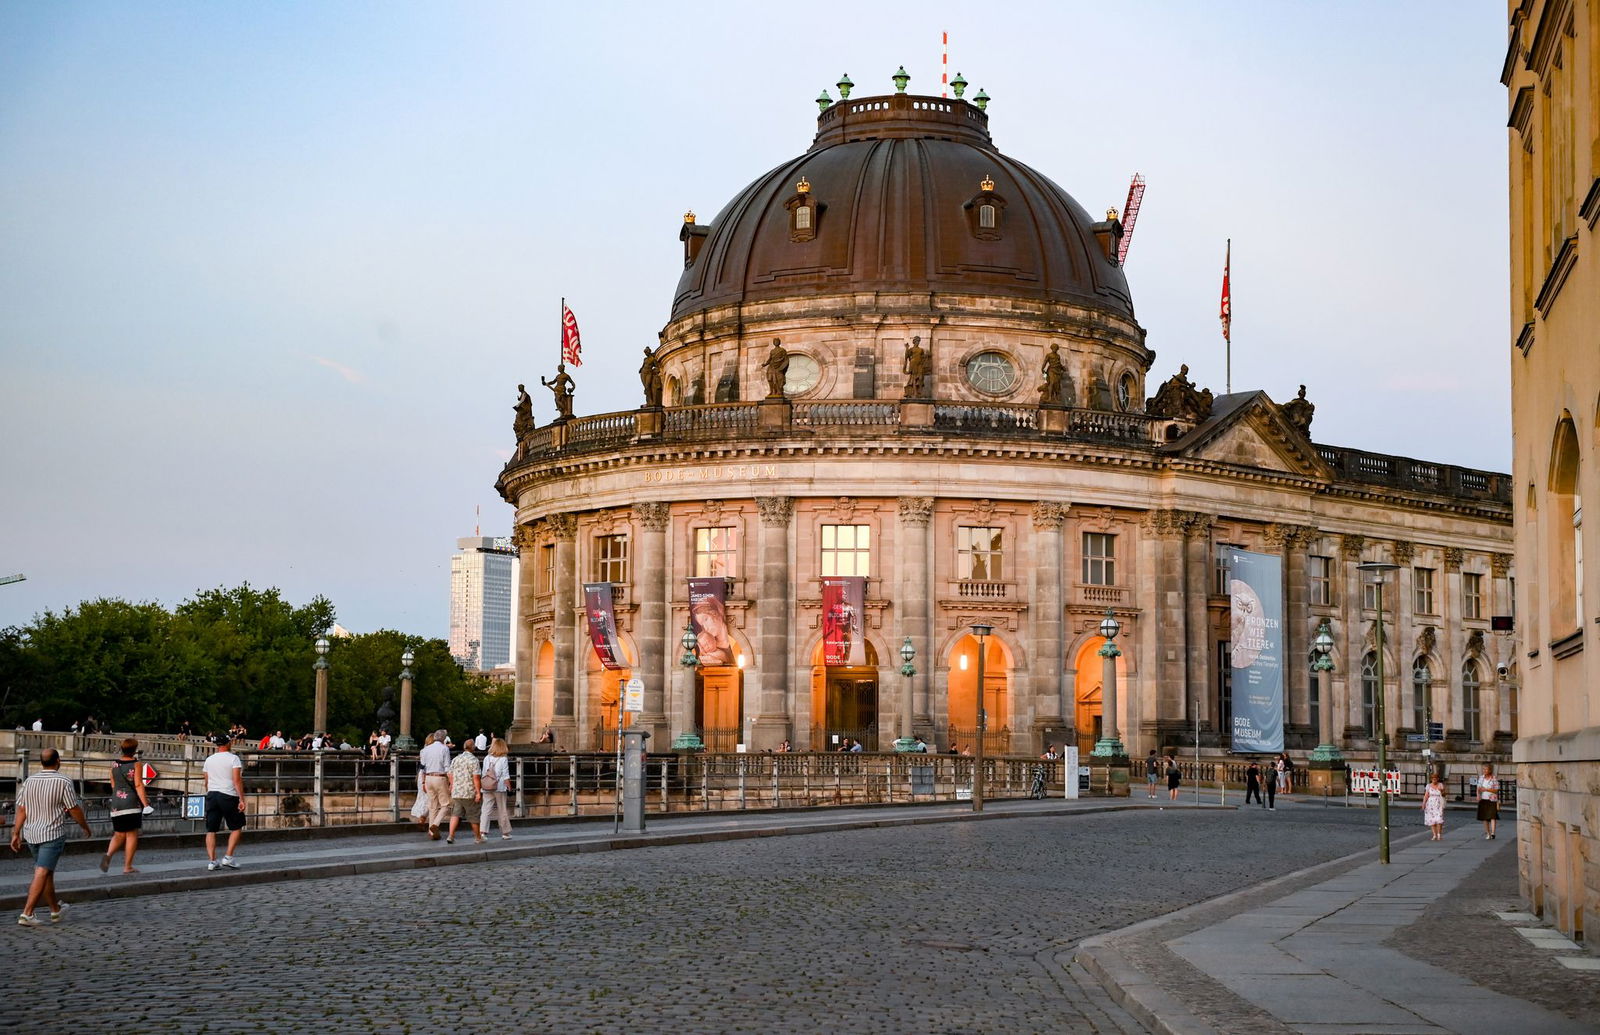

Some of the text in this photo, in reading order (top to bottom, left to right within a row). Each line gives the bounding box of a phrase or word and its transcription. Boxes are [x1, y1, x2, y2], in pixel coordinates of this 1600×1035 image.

[1234, 717, 1251, 728] BODE
[1234, 727, 1262, 738] MUSEUM
[187, 805, 200, 816] 20
